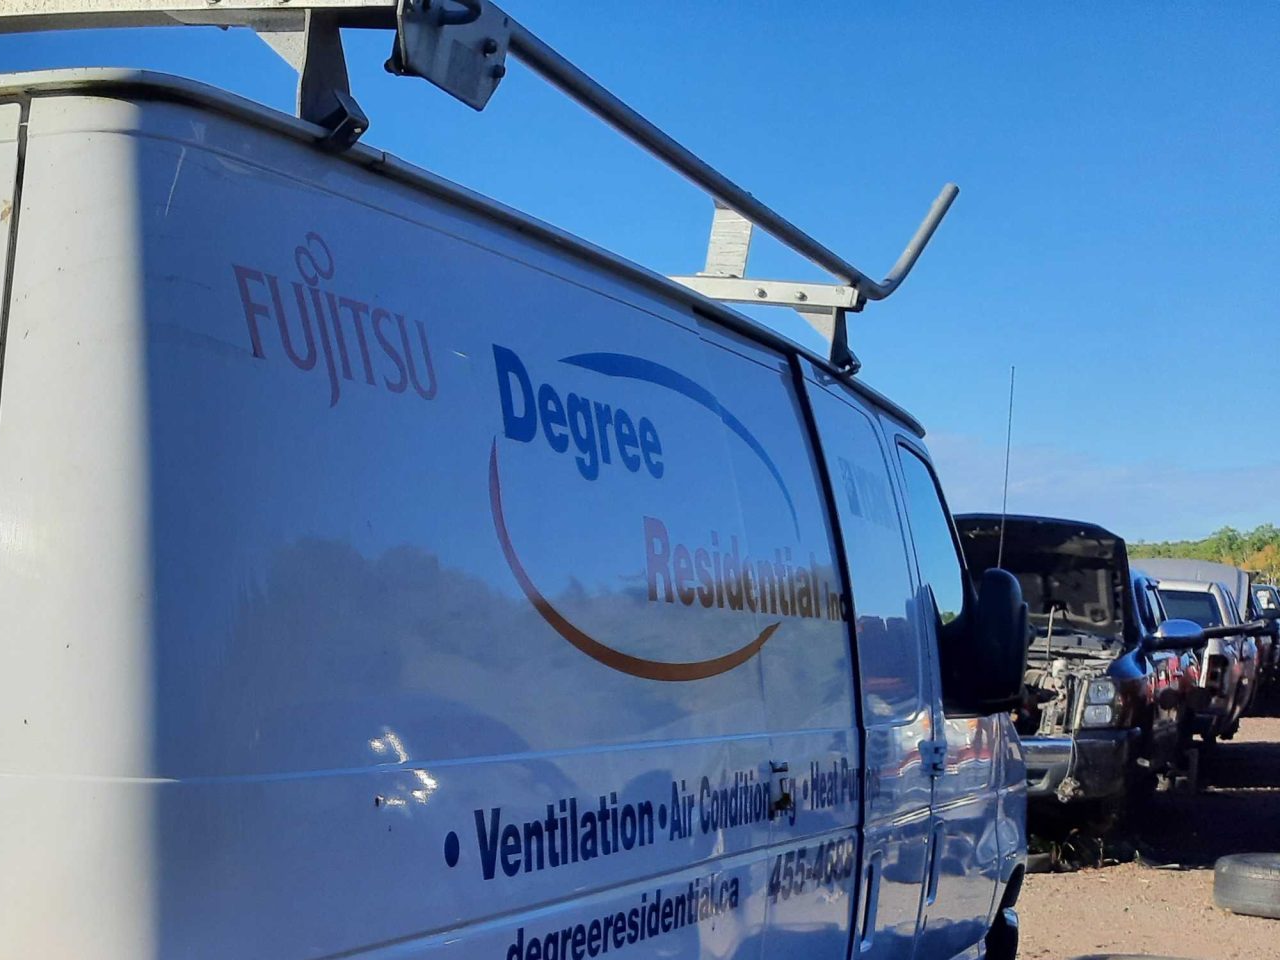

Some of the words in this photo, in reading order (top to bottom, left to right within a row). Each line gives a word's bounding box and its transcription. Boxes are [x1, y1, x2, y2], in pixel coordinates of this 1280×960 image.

[231, 263, 438, 409] FUJITSU
[491, 343, 664, 482] Degree
[642, 515, 822, 619] Residential
[473, 791, 655, 881] Ventilation
[668, 779, 696, 842] Air
[810, 760, 839, 811] Heat
